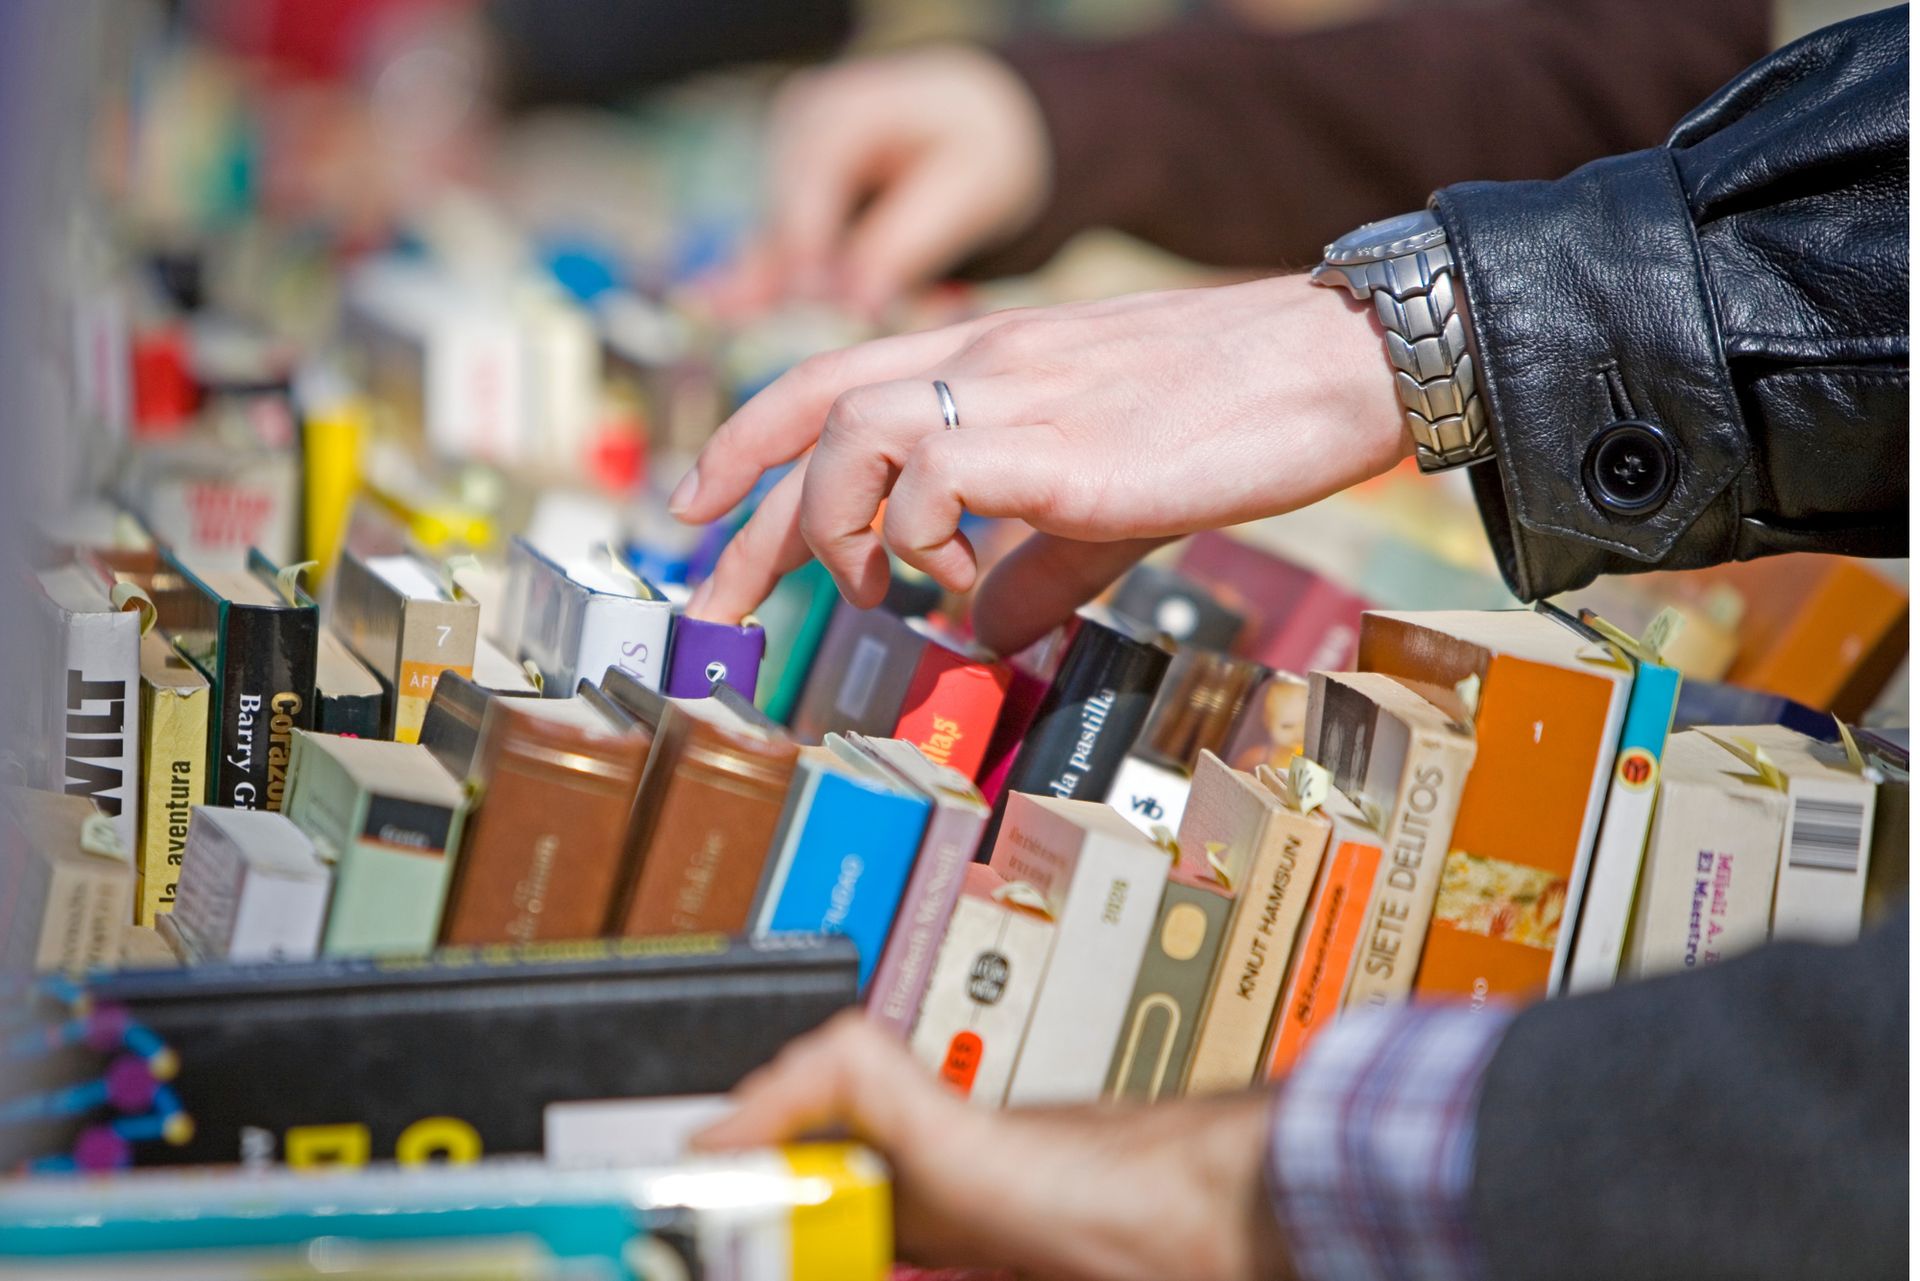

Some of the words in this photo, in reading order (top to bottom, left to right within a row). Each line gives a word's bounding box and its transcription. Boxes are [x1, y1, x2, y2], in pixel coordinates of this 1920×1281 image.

[436, 625, 452, 647] 7
[64, 669, 126, 818] WILT
[227, 693, 262, 773] Barry
[918, 713, 962, 765] llas
[1069, 688, 1117, 772] pastilla
[165, 760, 191, 866] aventura
[233, 781, 257, 811] Gi
[1386, 763, 1445, 892] DELITOS
[158, 883, 177, 903] la
[1697, 850, 1714, 873] El
[1236, 937, 1268, 1000] KNUT
[1257, 833, 1303, 937] HAMSUN
[1364, 898, 1411, 980] SIETE
[1684, 879, 1708, 967] Maestro
